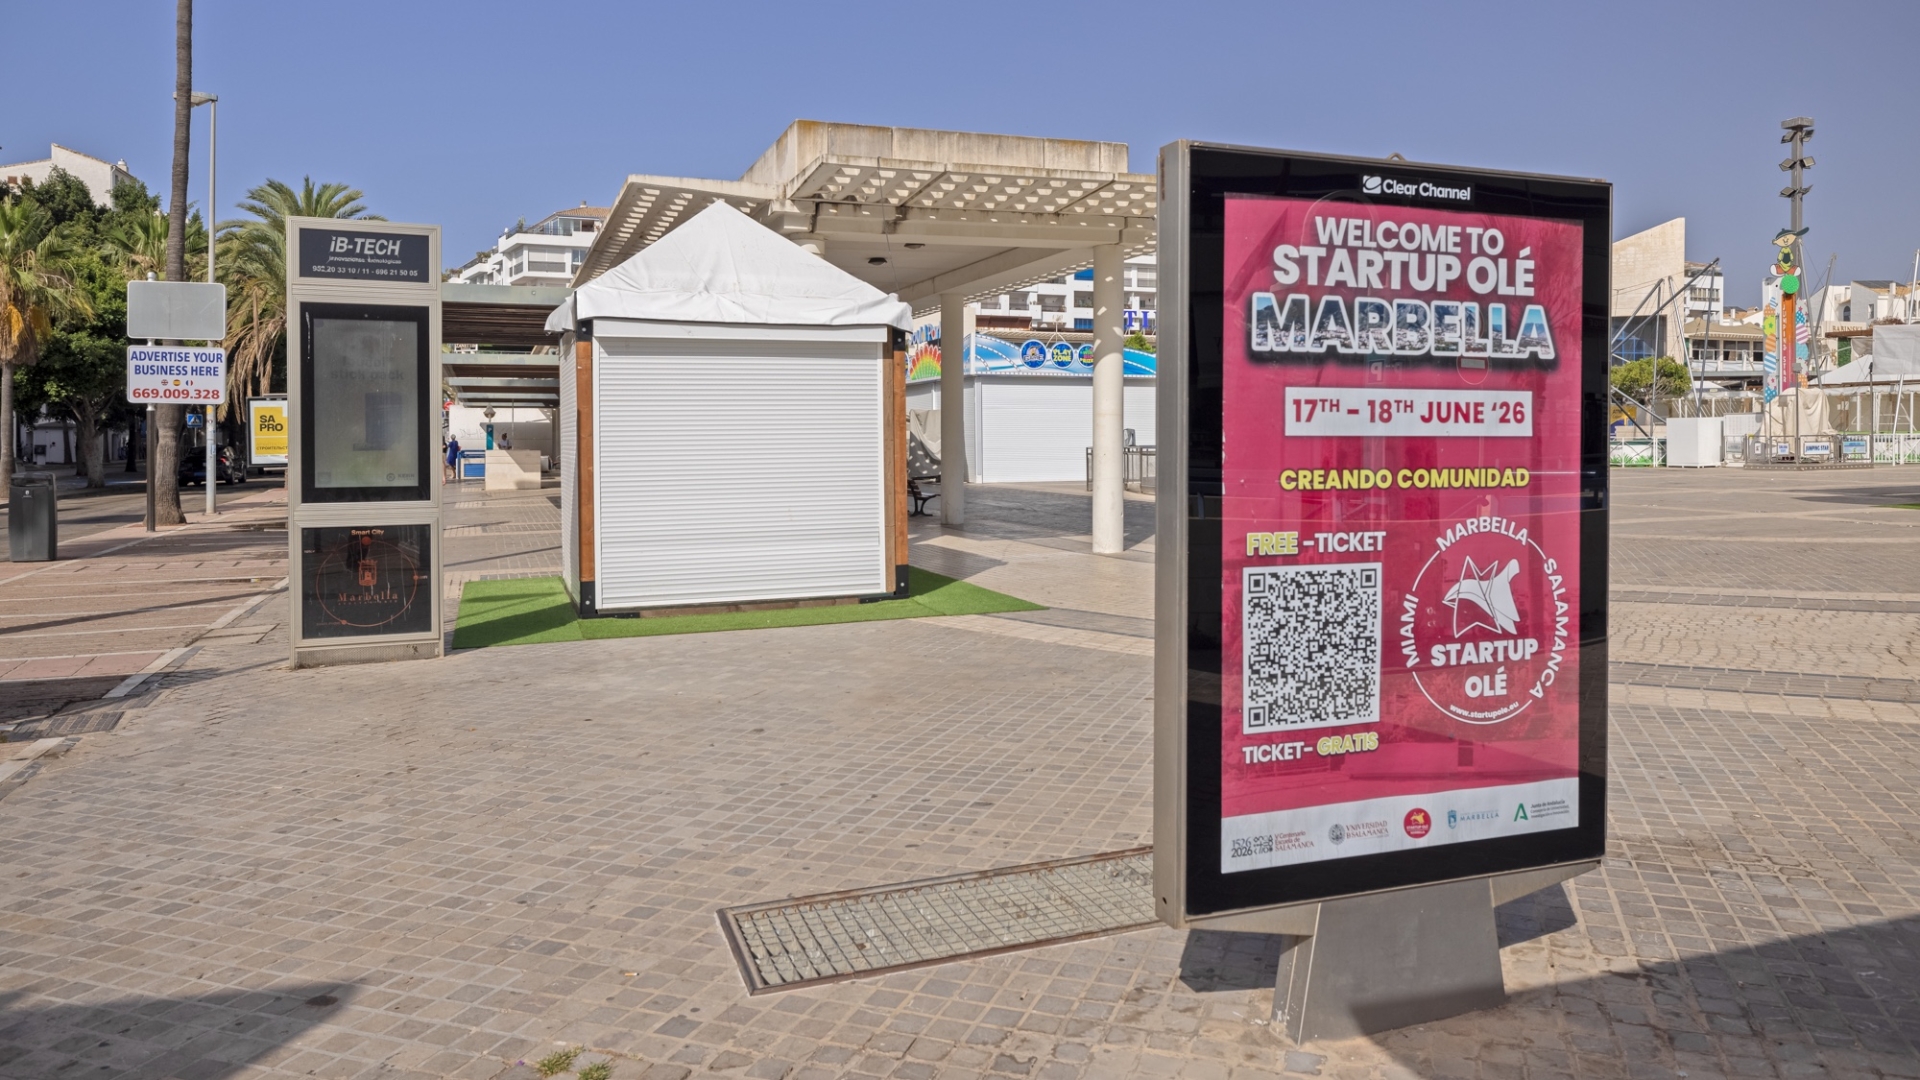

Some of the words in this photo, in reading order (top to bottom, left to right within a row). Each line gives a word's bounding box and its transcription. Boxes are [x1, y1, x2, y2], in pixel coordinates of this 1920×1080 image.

[1382, 179, 1418, 198] Clear
[1419, 181, 1471, 201] Channel
[329, 235, 402, 256] iB-TECH
[1314, 216, 1462, 254] WELCOME
[1464, 226, 1504, 256] TO
[1272, 244, 1461, 292] STARTUP
[1466, 246, 1535, 296] OLÉ
[1251, 291, 1556, 359] MARBELLA
[130, 350, 191, 363] ADVERTISE
[193, 352, 223, 363] YOUR
[134, 364, 188, 376] BUSINESS
[190, 365, 219, 377] HERE
[132, 388, 220, 400] 669.009.328
[259, 414, 276, 423] SA
[1292, 398, 1340, 424] 17TH
[1368, 399, 1414, 424] 18TH
[1420, 401, 1485, 424] JUNE
[259, 423, 284, 432] PRO
[1279, 468, 1393, 491] CREANDO
[1396, 467, 1530, 489] COMUNIDAD
[371, 529, 385, 537] City
[1246, 531, 1299, 556] FREE
[1436, 516, 1529, 551] MARBELLA
[338, 590, 399, 602] Marbella
[1400, 593, 1420, 669] MIAMI
[1529, 557, 1569, 699] SALAMANCA
[1430, 638, 1539, 667] STARTUP
[1464, 665, 1507, 699] OLÉ
[1449, 701, 1519, 719] www.startupole.eu
[1316, 732, 1379, 757] GRATIS
[1460, 812, 1500, 821] MARBELLA
[1231, 836, 1252, 848] 1526
[1231, 846, 1253, 858] 2026
